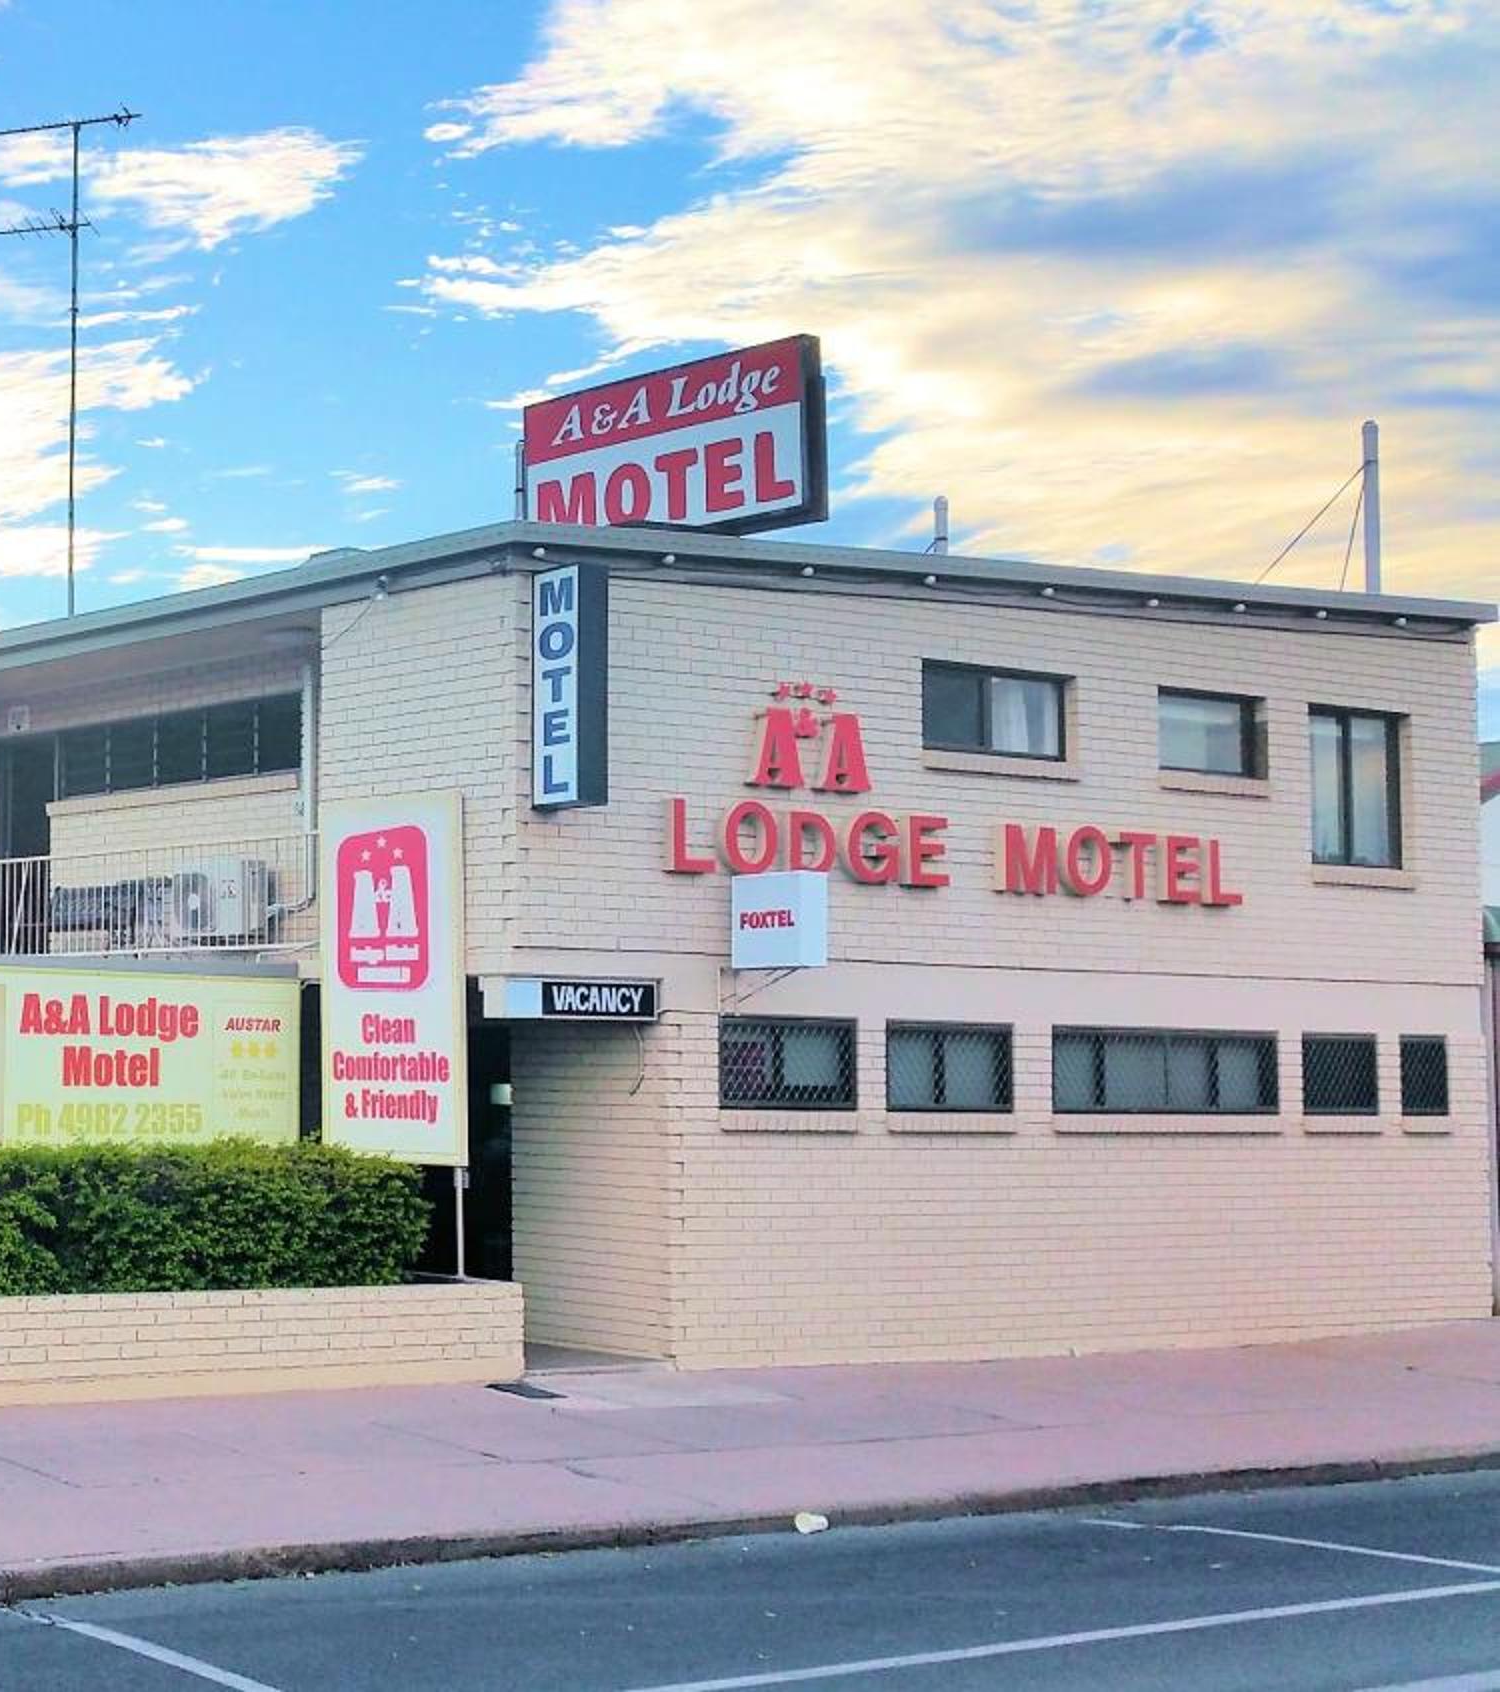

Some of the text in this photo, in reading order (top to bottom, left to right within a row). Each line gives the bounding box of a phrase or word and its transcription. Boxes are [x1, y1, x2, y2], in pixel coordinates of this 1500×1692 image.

[666, 362, 781, 419] Lodge
[536, 431, 795, 527] MOTEL
[538, 576, 575, 795] MOTEL
[668, 798, 1243, 906] LODGE MOTEL
[739, 909, 795, 930] FOXTEL
[552, 985, 644, 1014] VACANCY
[19, 993, 199, 1042] A&A Lodge
[224, 1017, 281, 1033] AUSTAR
[361, 1014, 415, 1044] Clean
[62, 1045, 160, 1087] Motel
[332, 1051, 451, 1083] Comfortable
[17, 1104, 202, 1134] Ph 4982 2355
[345, 1090, 439, 1124] & Friendly
